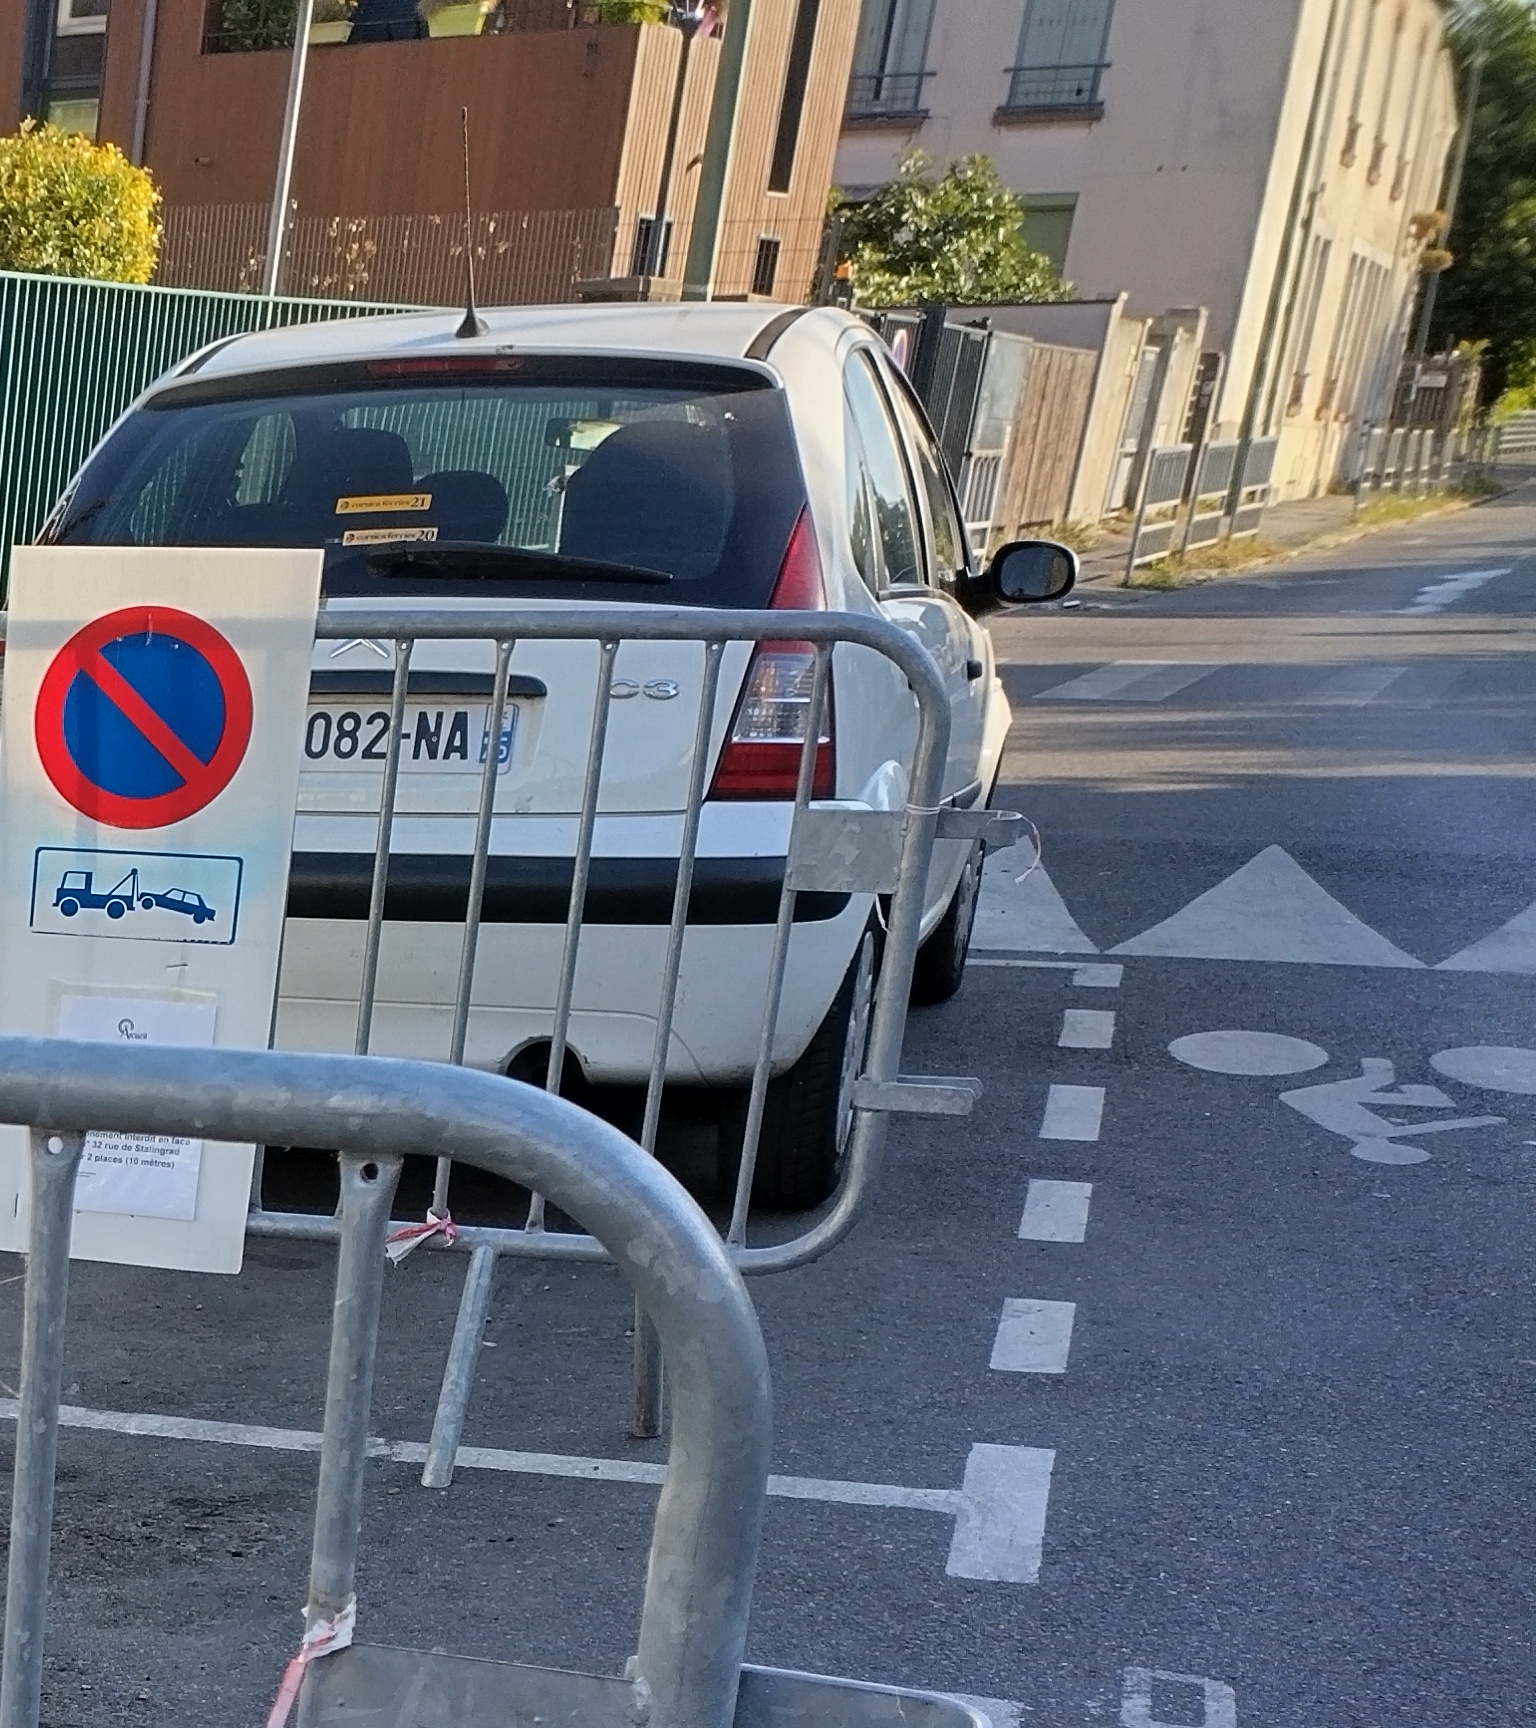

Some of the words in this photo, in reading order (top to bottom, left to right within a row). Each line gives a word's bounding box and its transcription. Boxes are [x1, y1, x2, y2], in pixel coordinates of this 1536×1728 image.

[610, 679, 679, 700] C3
[305, 711, 468, 760] 082-NA
[91, 1140, 103, 1149] 32
[121, 1143, 132, 1152] de
[134, 1144, 180, 1156] Stalingrad
[87, 1153, 93, 1161] 2
[94, 1154, 123, 1163] places
